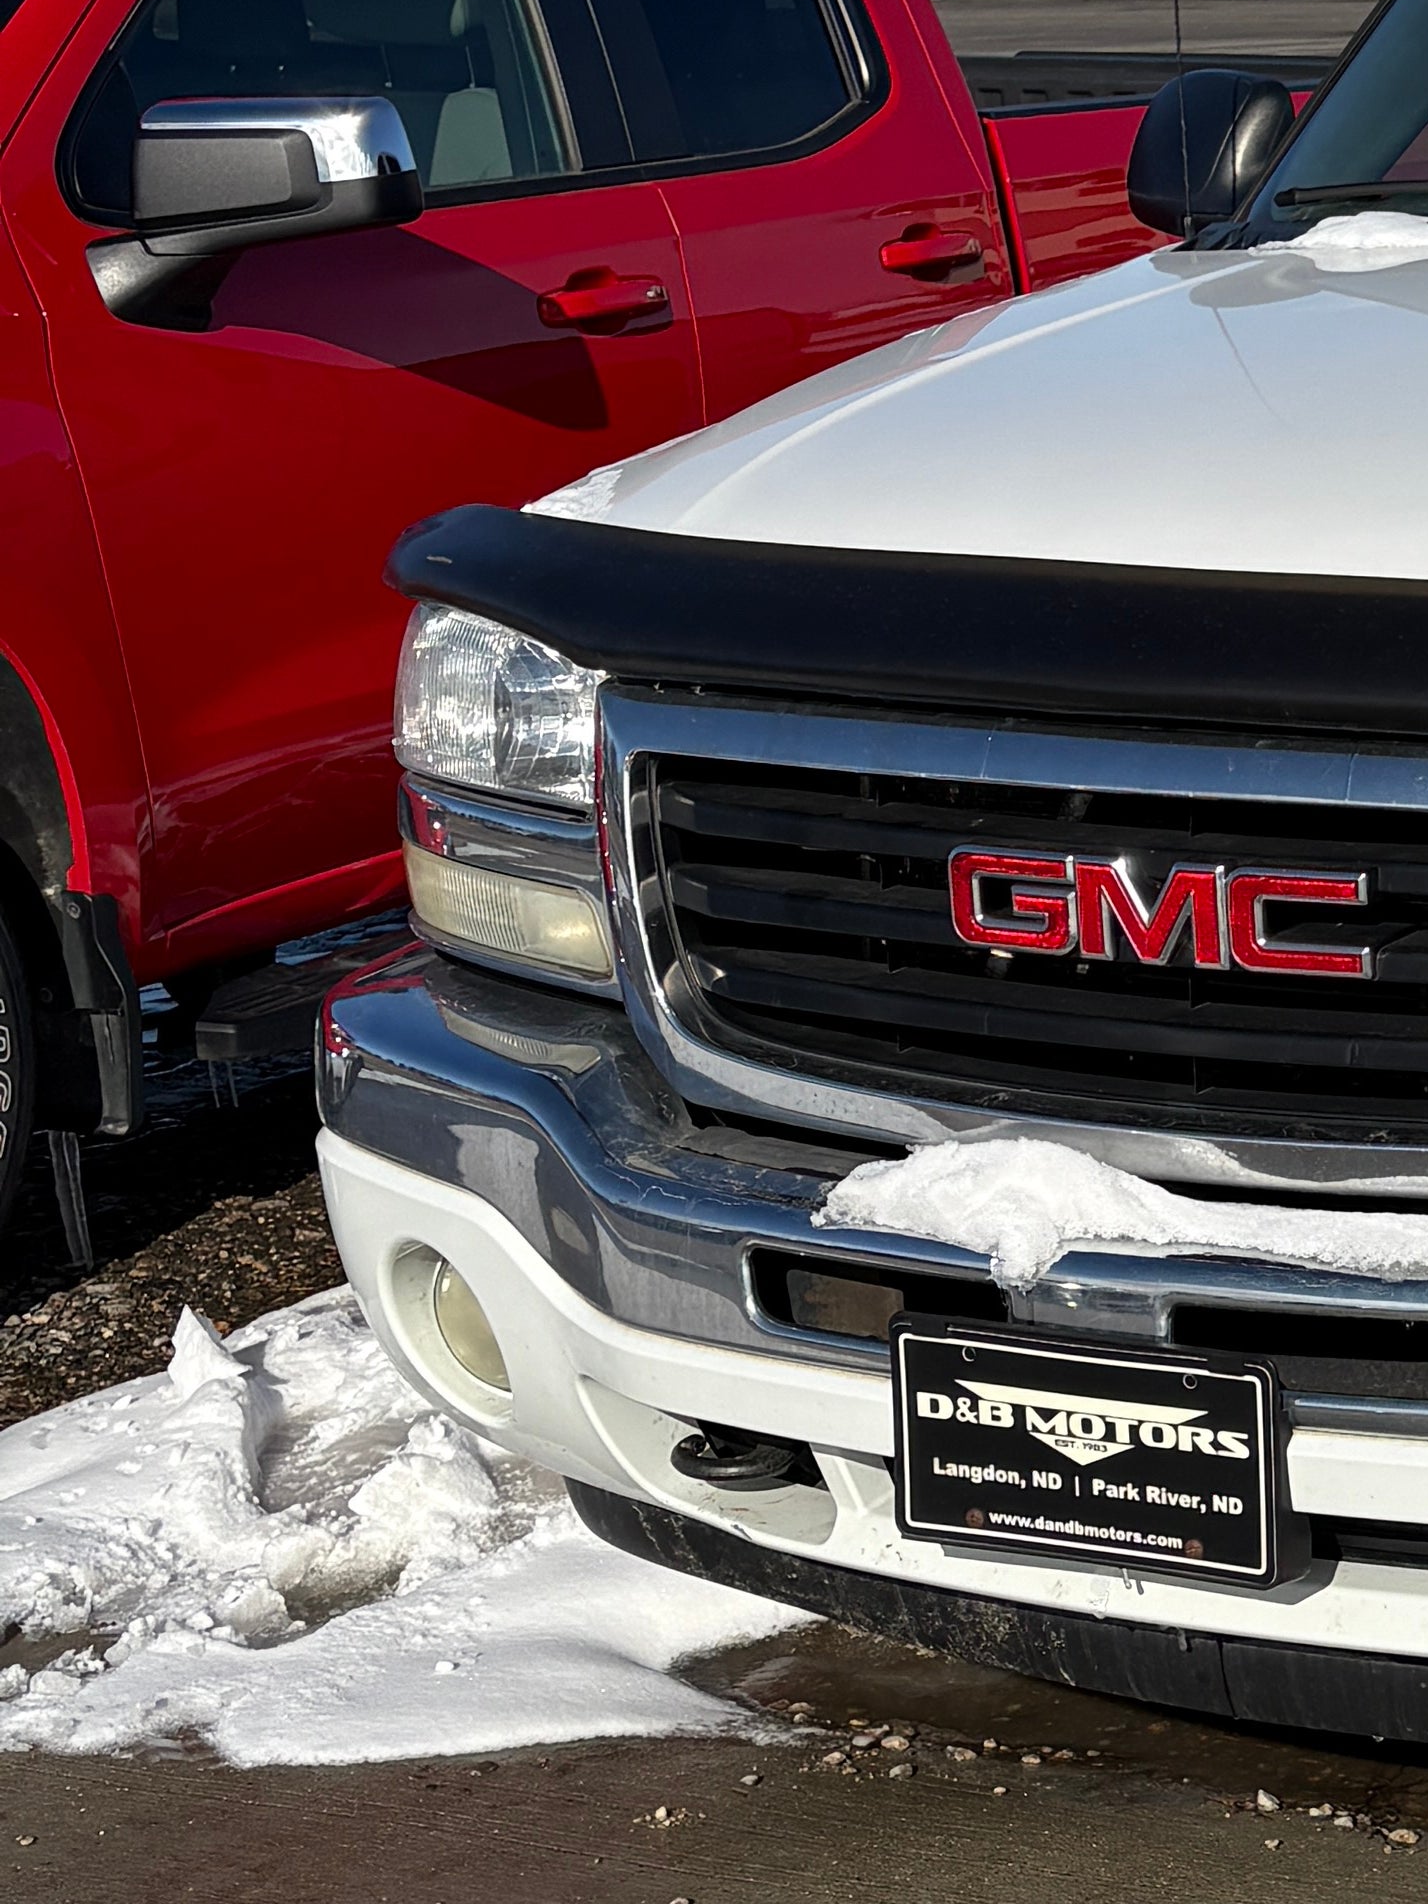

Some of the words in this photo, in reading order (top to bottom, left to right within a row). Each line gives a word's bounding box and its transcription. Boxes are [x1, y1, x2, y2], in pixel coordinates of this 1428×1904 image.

[948, 844, 1374, 980] GMC
[916, 1391, 1014, 1428] D&B
[1025, 1405, 1250, 1460] MOTORS
[1054, 1438, 1079, 1450] EST.
[932, 1456, 1026, 1489] Langdon,
[1032, 1469, 1062, 1490] ND
[1091, 1478, 1140, 1501] Park
[1145, 1484, 1207, 1514] River,
[1212, 1494, 1243, 1515] ND
[988, 1512, 1183, 1549] www.dandbmotors.com
